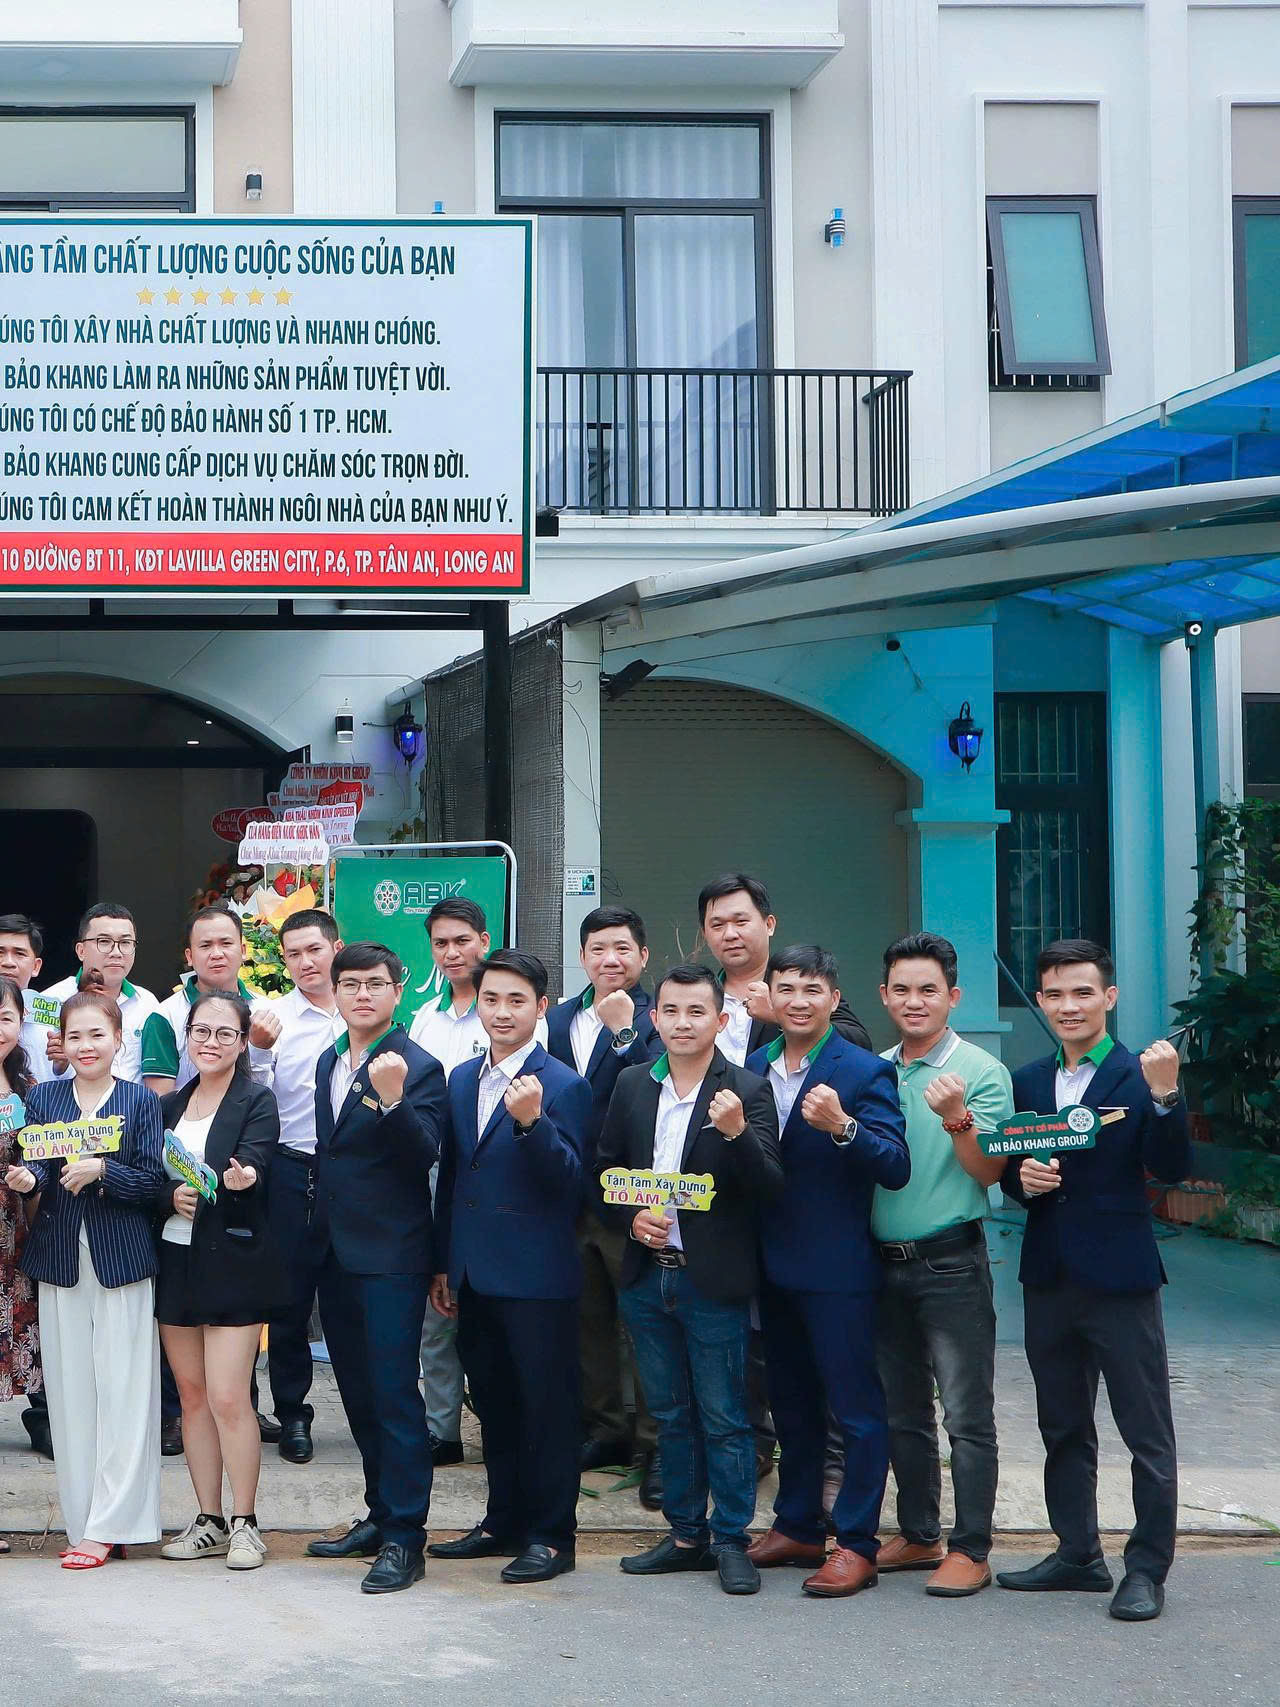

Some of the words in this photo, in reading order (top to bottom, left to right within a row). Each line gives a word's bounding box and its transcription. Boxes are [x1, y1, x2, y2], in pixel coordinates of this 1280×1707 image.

[40, 236, 86, 274] TẦM
[95, 235, 151, 274] CHẤT
[158, 244, 228, 280] LƯỢNG
[235, 240, 290, 280] CUỘC
[298, 237, 354, 275] SỐNG
[362, 237, 403, 274] CỦA
[412, 246, 455, 281] BẠN
[40, 315, 67, 344] TÔI
[74, 315, 110, 344] XÂY
[117, 315, 153, 344] NHÀ
[160, 312, 206, 344] CHẤT
[213, 319, 270, 349] LƯỢNG
[277, 315, 299, 345] VÀ
[306, 320, 368, 345] NHANH
[375, 316, 441, 345] CHÓNG.
[5, 358, 40, 390] BẢO
[47, 365, 107, 390] KHANG
[114, 361, 150, 390] LÀM
[158, 366, 180, 390] RA
[187, 361, 248, 390] NHỮNG
[254, 358, 290, 391] SẢN
[296, 355, 347, 391] PHẨM
[354, 361, 410, 396] TUYỆT
[416, 362, 451, 391] VỜI.
[40, 403, 67, 433] TÔI
[74, 403, 96, 433] CÓ
[102, 401, 139, 433] CHẾ
[141, 403, 166, 438] ĐỘ
[172, 401, 207, 433] BẢO
[213, 404, 262, 433] HÀNH
[269, 401, 294, 434] SỐ
[300, 409, 306, 433] 1
[314, 409, 341, 434] TP.
[347, 409, 392, 434] HCM.
[5, 445, 40, 477] BẢO
[46, 453, 107, 477] KHANG
[113, 453, 160, 477] CUNG
[166, 445, 201, 477] CẤP
[207, 453, 247, 483] DỊCH
[254, 453, 278, 483] VỤ
[284, 449, 335, 478] CHĂM
[342, 448, 375, 478] SÓC
[381, 454, 428, 484] TRỌN
[434, 448, 469, 479] ĐỜI.
[39, 491, 66, 521] TÔI
[73, 497, 112, 521] CAM
[118, 489, 152, 522] KẾT
[158, 491, 206, 522] HOÀN
[213, 492, 273, 522] THÀNH
[280, 493, 322, 522] NGÔI
[328, 492, 364, 523] NHÀ
[371, 490, 405, 523] CỦA
[412, 499, 447, 528] BẠN
[454, 497, 491, 523] NHƯ
[496, 494, 513, 523] Ý.
[2, 549, 19, 571] 10
[24, 544, 82, 572] ĐƯỜNG
[87, 549, 103, 571] BT
[109, 549, 130, 576] 11,
[135, 550, 164, 572] KĐT
[169, 550, 225, 572] LAVILLA
[231, 550, 278, 572] GREEN
[284, 549, 320, 577] CITY,
[326, 551, 350, 577] P.6,
[355, 551, 374, 573] TP.
[379, 545, 408, 573] TÂN
[413, 551, 438, 577] AN,
[445, 551, 487, 573] LONG
[492, 551, 514, 573] AN
[23, 1132, 41, 1145] Tận
[44, 1130, 65, 1141] Tâm
[67, 1127, 85, 1140] Xây
[88, 1125, 114, 1138] Dựng
[988, 1141, 1002, 1153] AN
[1003, 1137, 1022, 1152] BẢO
[1023, 1137, 1056, 1151] KHANG
[1058, 1134, 1089, 1147] GROUP
[606, 1174, 626, 1189] Tận
[630, 1176, 652, 1188] Tâm
[655, 1178, 675, 1192] Xây
[679, 1180, 706, 1195] Dựng
